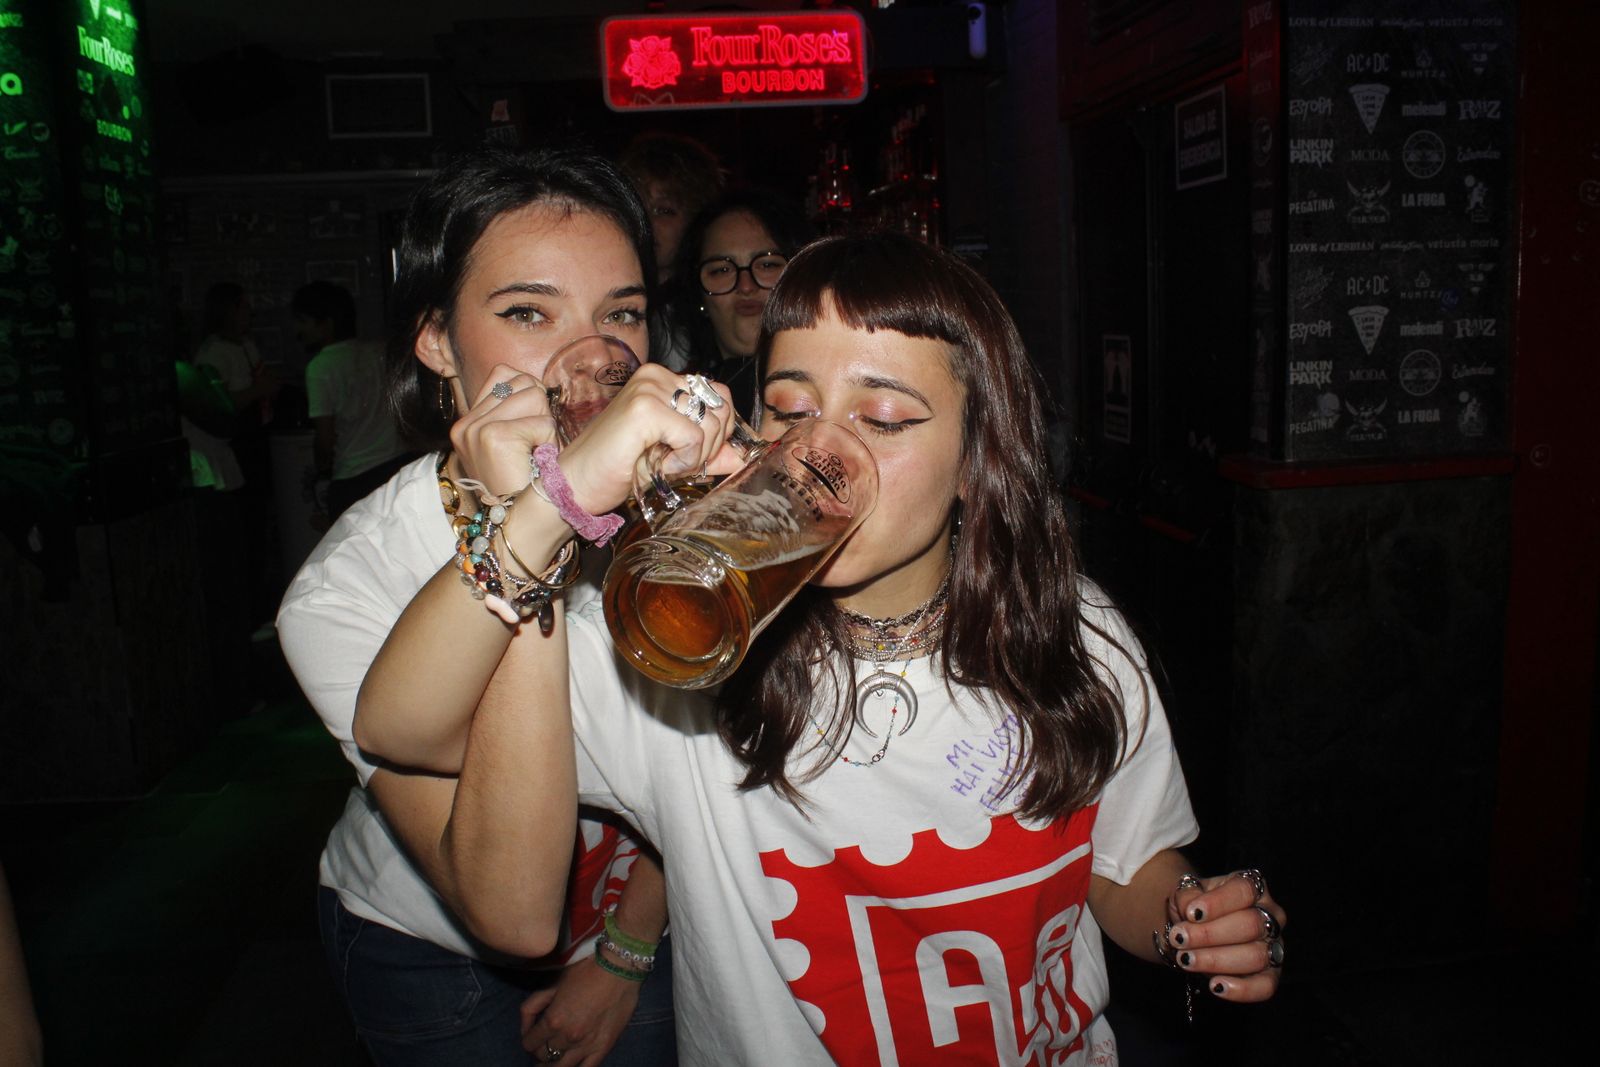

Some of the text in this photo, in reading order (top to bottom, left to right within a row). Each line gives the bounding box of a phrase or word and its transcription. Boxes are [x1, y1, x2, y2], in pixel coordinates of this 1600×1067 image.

[1289, 18, 1318, 27] LOVE
[1330, 17, 1374, 27] LESBIAN
[722, 69, 825, 93] BOURBON
[1184, 108, 1217, 139] SALIDA DE
[1290, 139, 1334, 151] LINKIN
[1290, 150, 1333, 169] PARK
[1288, 198, 1335, 215] PEGATINA
[1402, 192, 1446, 208] LA FUGA
[1289, 243, 1318, 253] LOVE
[1400, 321, 1444, 337] melendi
[1289, 360, 1333, 372] LINKIN
[1289, 371, 1332, 389] PARK
[1398, 408, 1441, 424] LA FUGA
[1289, 417, 1335, 435] PEGATINA
[946, 739, 974, 769] MI
[950, 763, 984, 797] HAI
